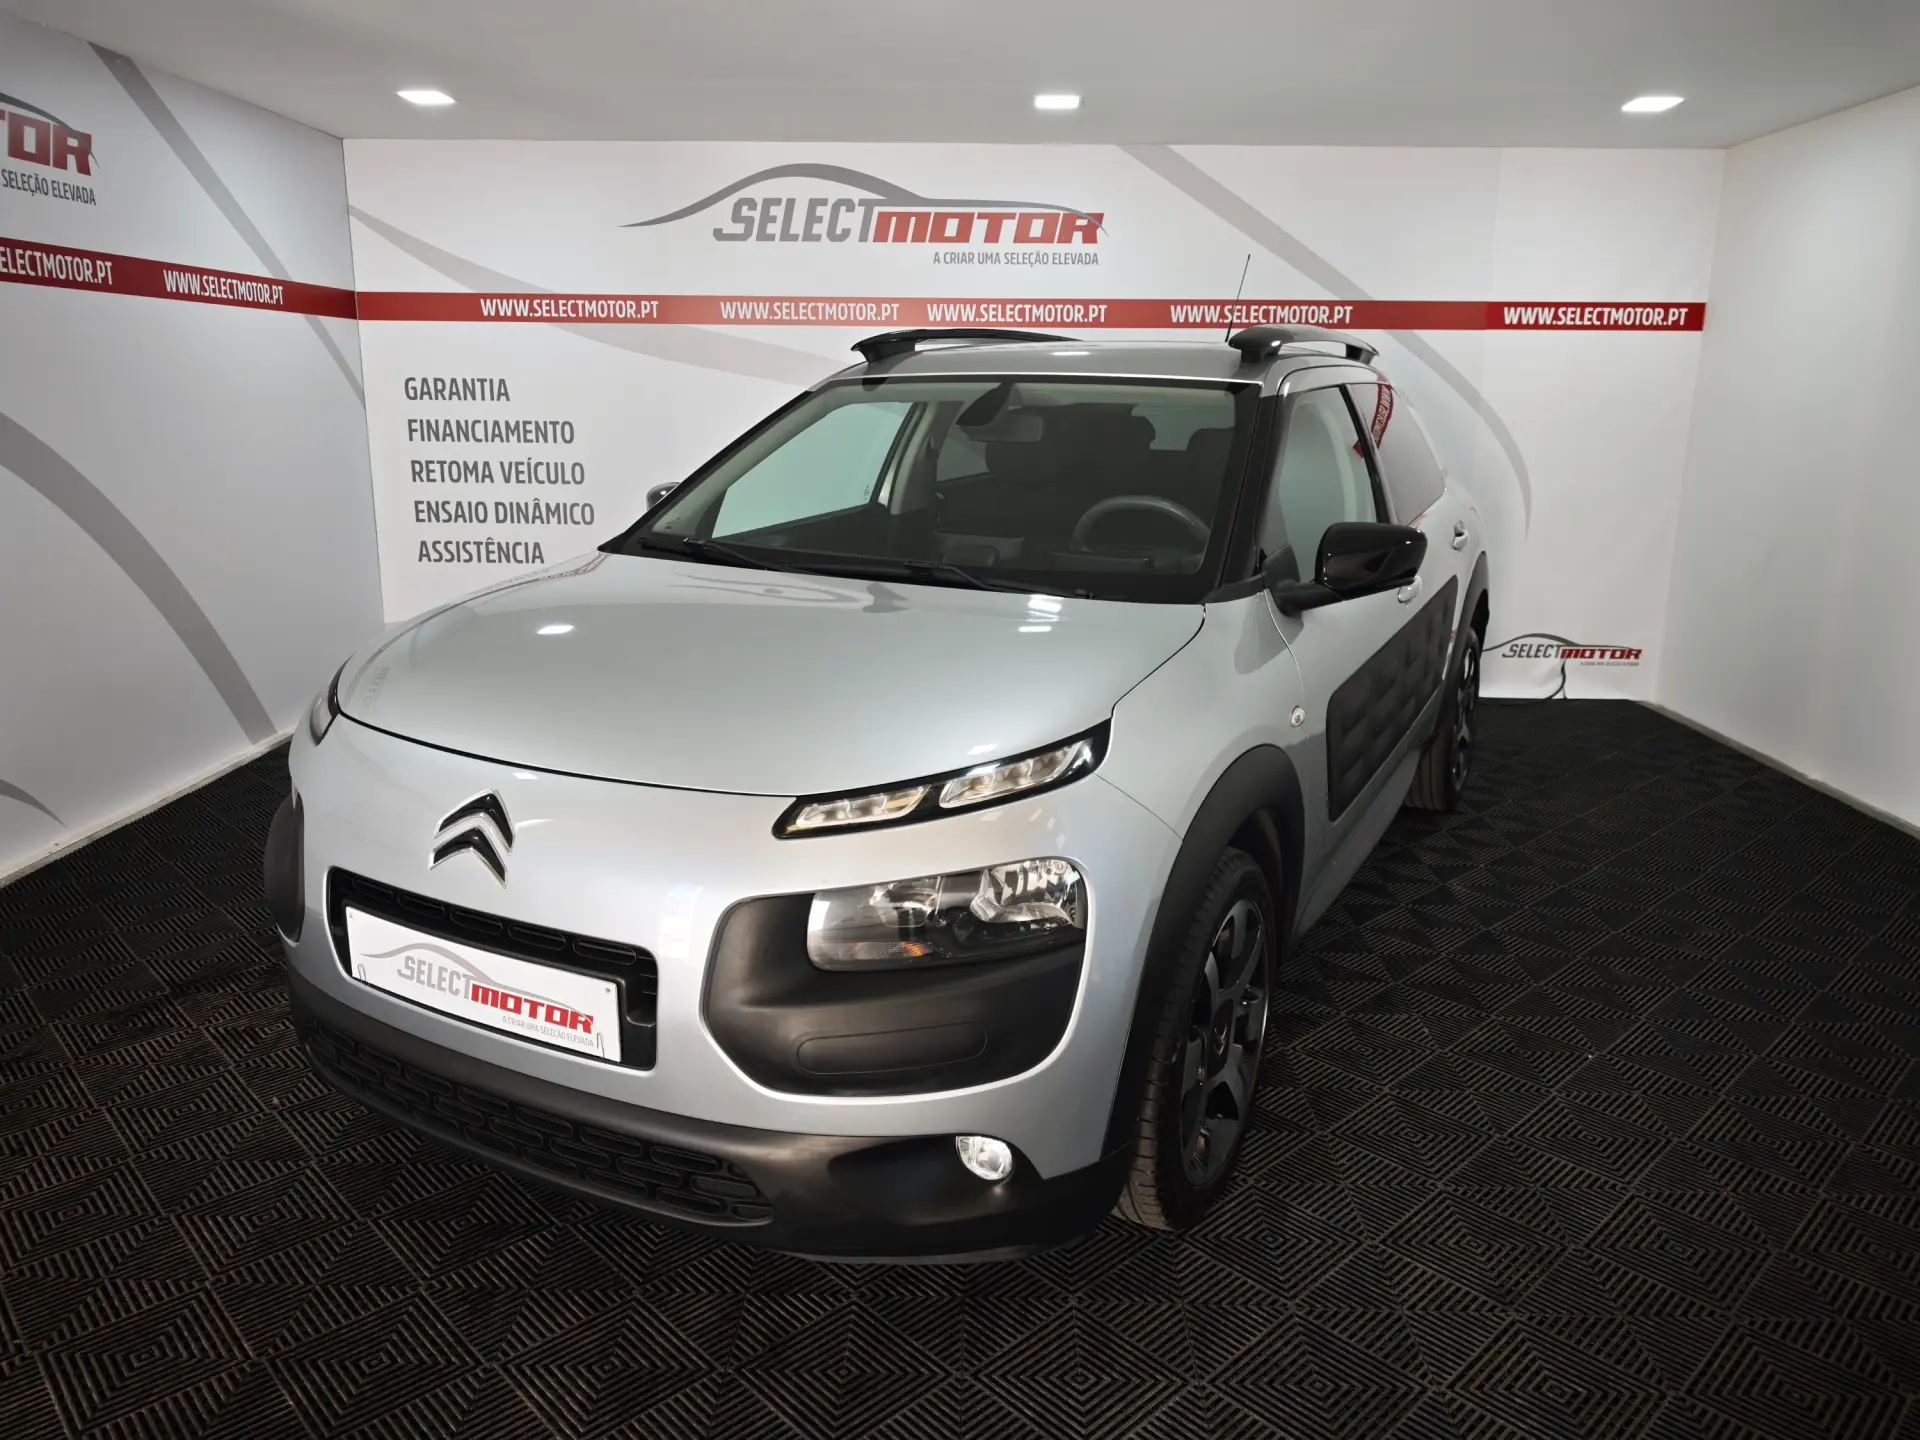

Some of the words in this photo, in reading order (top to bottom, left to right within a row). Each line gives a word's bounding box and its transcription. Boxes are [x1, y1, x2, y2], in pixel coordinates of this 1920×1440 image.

[0, 109, 92, 177] OR
[1, 168, 49, 197] SELEÇÃO
[51, 179, 96, 205] ELEVADA
[712, 197, 1105, 244] SELECTMOTOR
[933, 252, 941, 265] A
[943, 252, 975, 265] CRIAR
[977, 252, 1001, 265] UMA
[1004, 250, 1049, 267] SELEÇÃO
[1052, 252, 1099, 266] ELEVADA
[163, 269, 284, 305] WWW.SELECTMOTOR.PT
[480, 298, 659, 319] WWW.SELECTMOTOR.PT
[720, 301, 899, 321] WWW.SELECTMOTOR.PT
[927, 303, 1107, 323] WWW.SELECTMOTOR.PT
[1170, 304, 1353, 325] WWW.SELECTMOTOR.PT
[1503, 306, 1688, 326] WWW.SELECTMOTOR.PT
[404, 377, 510, 401] GARANTIA
[407, 419, 575, 444] FINANCIAMENTO
[410, 459, 495, 484] RETOMA
[499, 457, 585, 485] VEÍCULO
[414, 500, 489, 523] ENSAIO
[494, 498, 595, 525] DINÂMICO
[418, 537, 545, 564] ASSISTÊNCIA
[1502, 643, 1642, 659] SELECTMOTOR
[396, 955, 594, 1034] SELECTMOTOR
